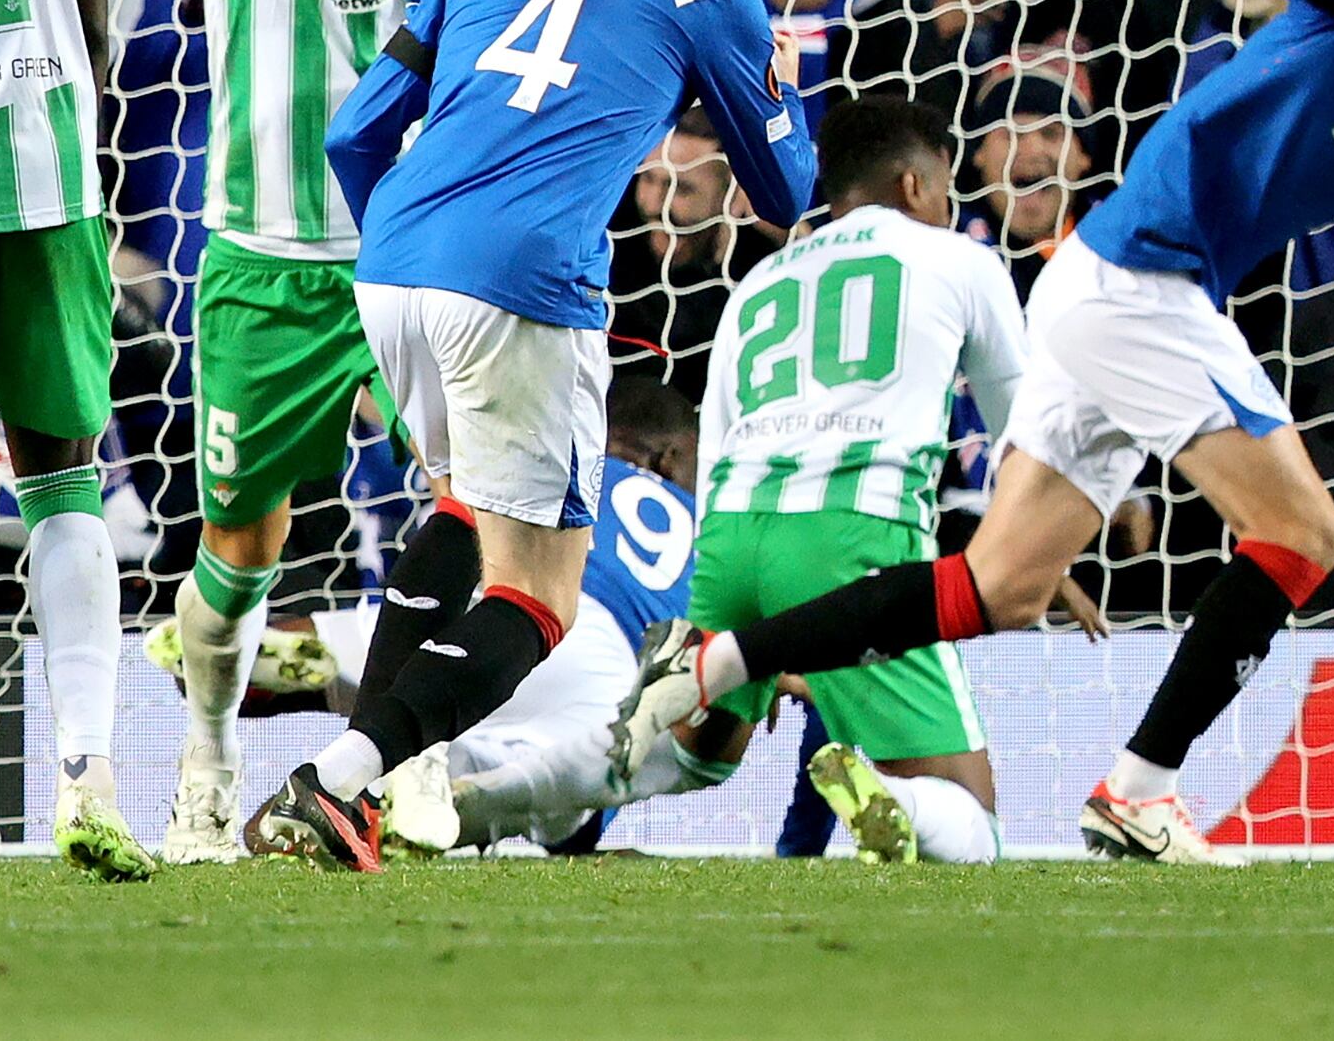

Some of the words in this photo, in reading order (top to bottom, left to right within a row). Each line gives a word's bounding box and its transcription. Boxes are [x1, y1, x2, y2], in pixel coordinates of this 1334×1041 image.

[11, 55, 63, 79] GREEN
[736, 254, 910, 419] 20
[205, 404, 239, 478] 5
